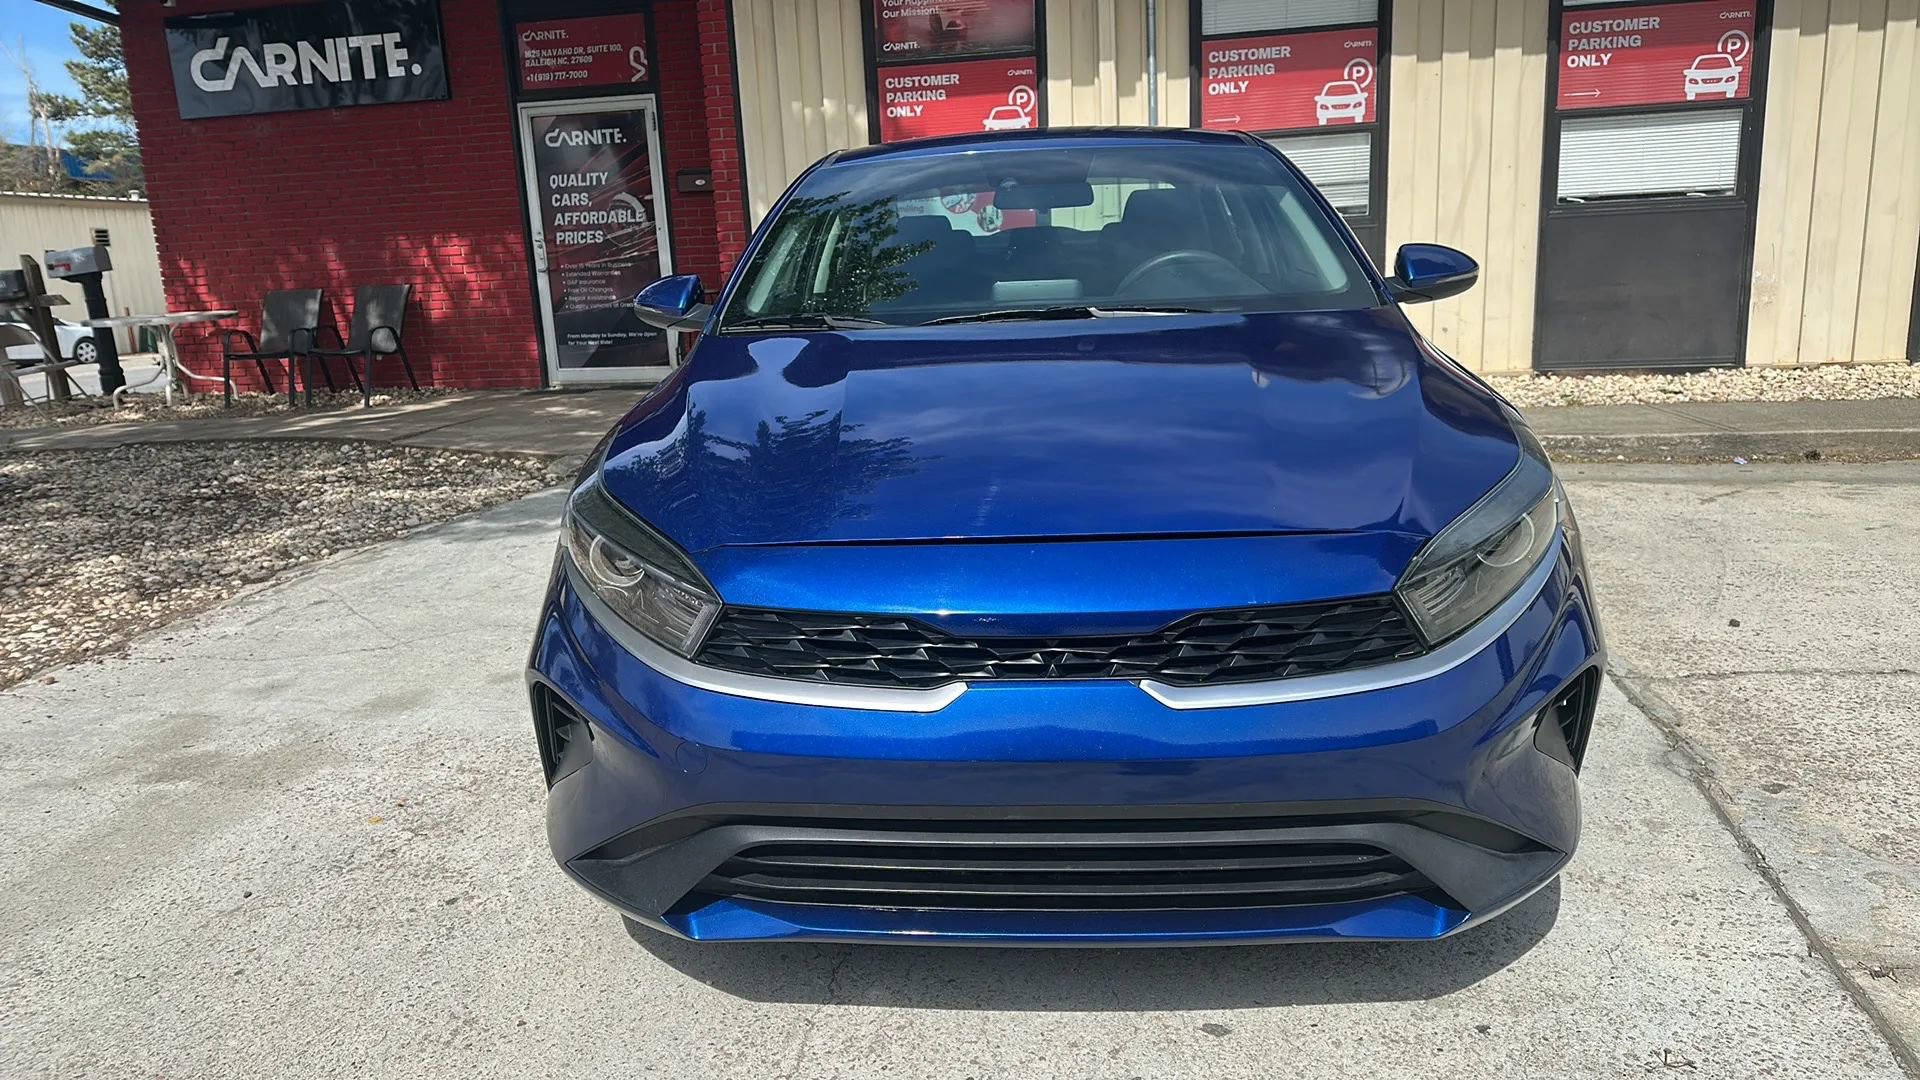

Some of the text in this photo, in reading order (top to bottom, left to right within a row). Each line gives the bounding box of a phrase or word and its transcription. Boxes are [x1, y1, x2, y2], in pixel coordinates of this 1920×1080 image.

[882, 5, 939, 18] Our Mission!
[1569, 17, 1660, 35] CUSTOMER
[1568, 35, 1642, 51] PARKING
[541, 47, 572, 57] NAVAHO
[587, 45, 608, 54] SUITE
[1208, 45, 1291, 63] CUSTOMER
[190, 32, 422, 92] CARNITE.
[525, 58, 557, 68] RALEIGH
[1567, 53, 1612, 67] ONLY
[1208, 63, 1275, 79] PARKING
[885, 74, 960, 89] CUSTOMER
[1208, 81, 1249, 95] ONLY
[886, 89, 946, 103] PARKING
[887, 105, 923, 118] ONLY
[545, 128, 627, 147] CARNITE.
[550, 172, 608, 189] QUALITY
[552, 193, 592, 207] CARS,
[554, 209, 646, 226] AFFORDABLE
[556, 230, 604, 245] PRICES
